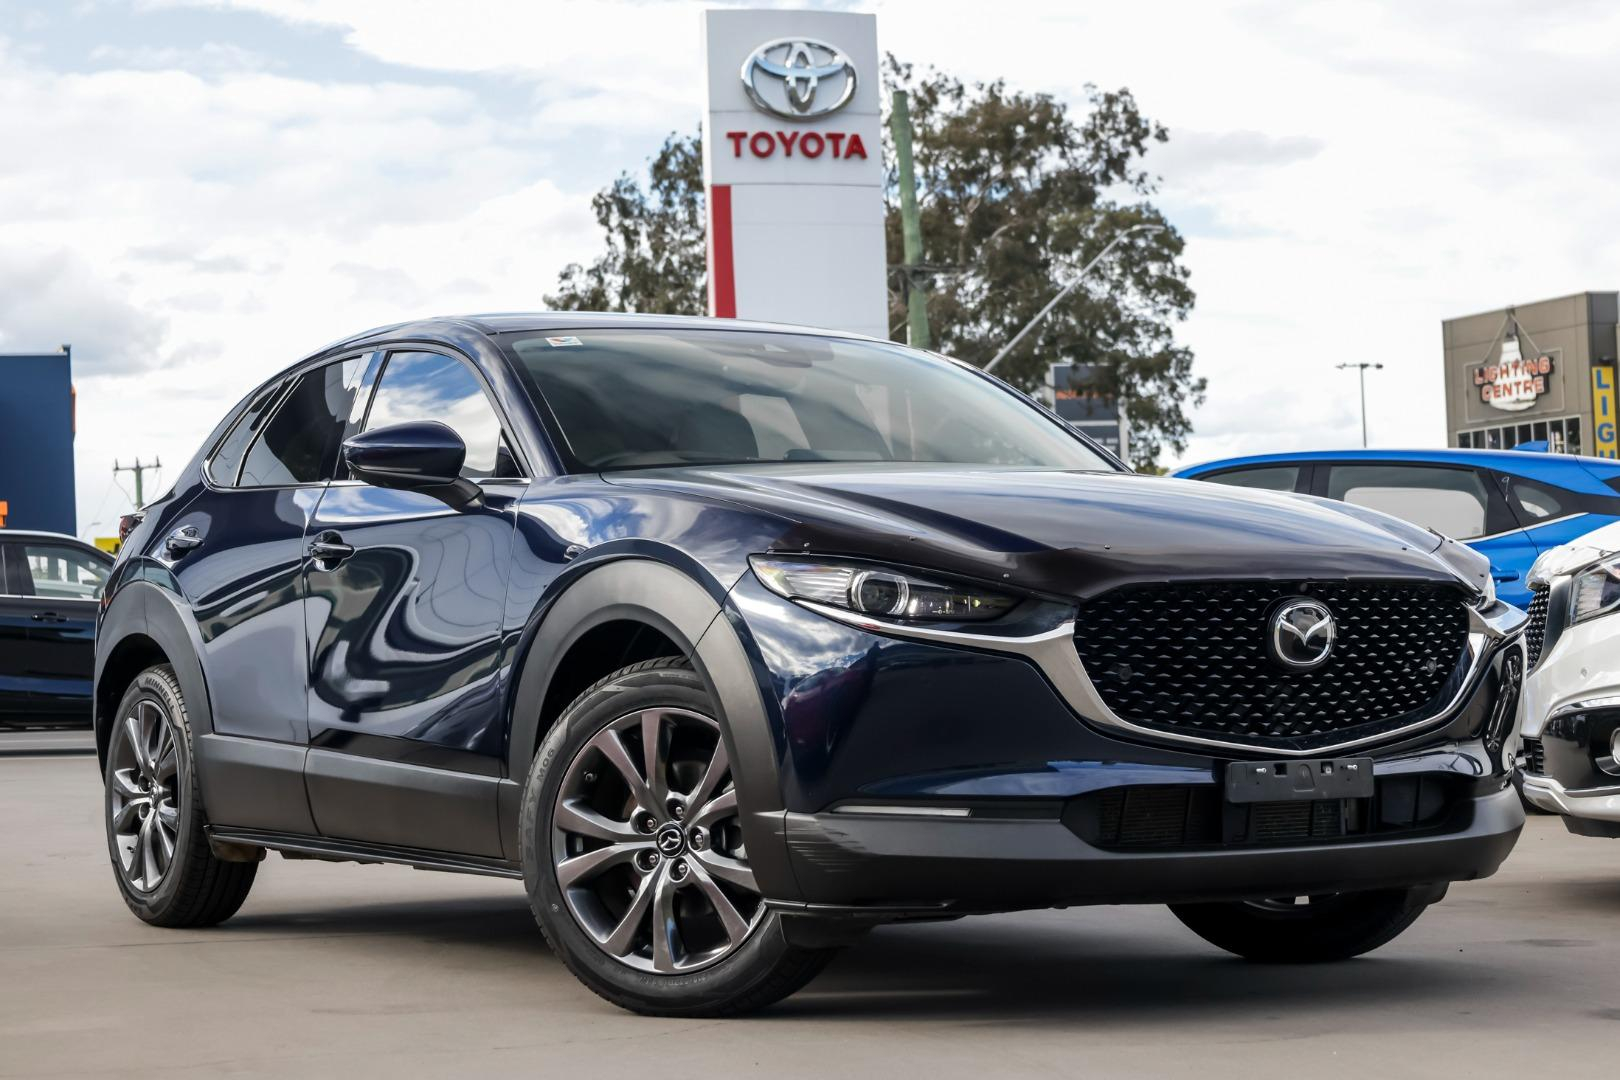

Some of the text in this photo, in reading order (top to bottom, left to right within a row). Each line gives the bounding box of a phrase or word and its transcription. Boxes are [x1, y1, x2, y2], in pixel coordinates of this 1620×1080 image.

[726, 131, 868, 159] TOYOTA
[1473, 356, 1551, 385] LIGHTING
[1481, 375, 1545, 401] CENTRE
